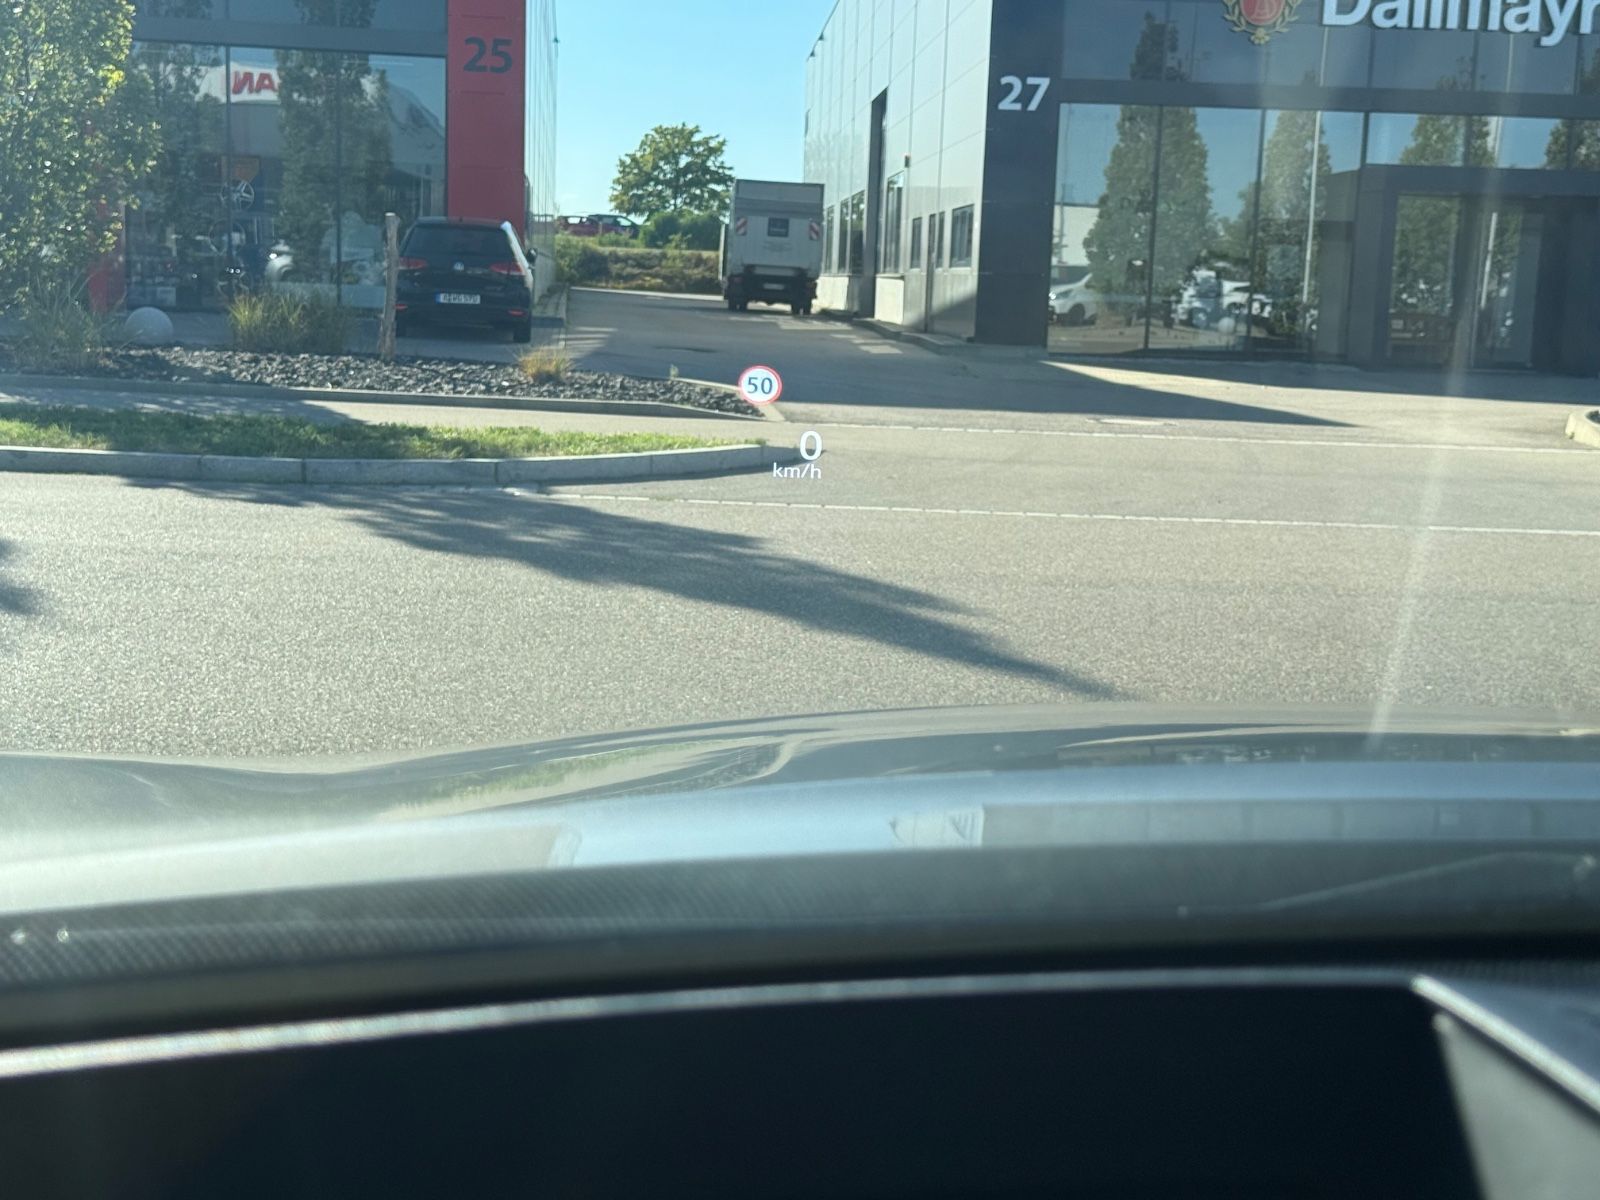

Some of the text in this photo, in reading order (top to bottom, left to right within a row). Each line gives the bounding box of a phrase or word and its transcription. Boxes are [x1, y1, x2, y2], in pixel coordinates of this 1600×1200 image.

[1322, 0, 1600, 47] Dallmayr
[463, 37, 513, 74] 25
[998, 75, 1050, 111] 27
[747, 376, 773, 395] 50
[800, 430, 822, 461] 0
[773, 462, 822, 479] km/h
